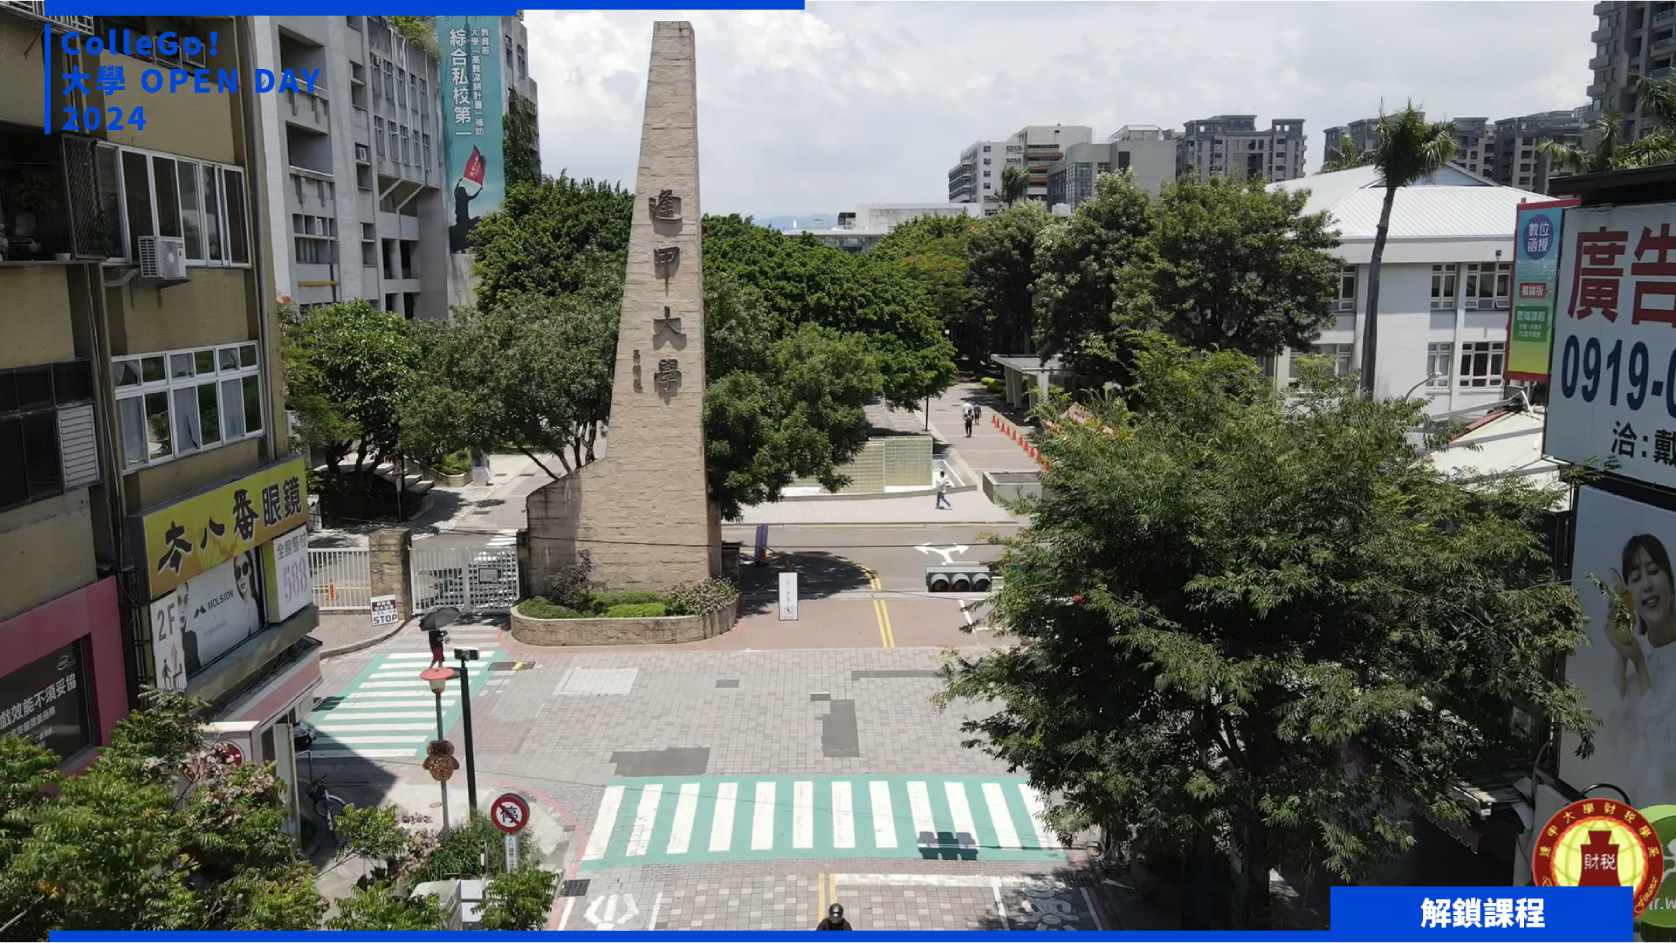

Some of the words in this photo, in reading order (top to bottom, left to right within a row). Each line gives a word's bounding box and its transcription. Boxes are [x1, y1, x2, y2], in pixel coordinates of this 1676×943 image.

[449, 27, 472, 135] 綜合私校第一
[648, 189, 687, 406] 逢甲大學
[1567, 223, 1676, 328] 廣告
[157, 602, 176, 642] 2F
[373, 613, 399, 625] STOP
